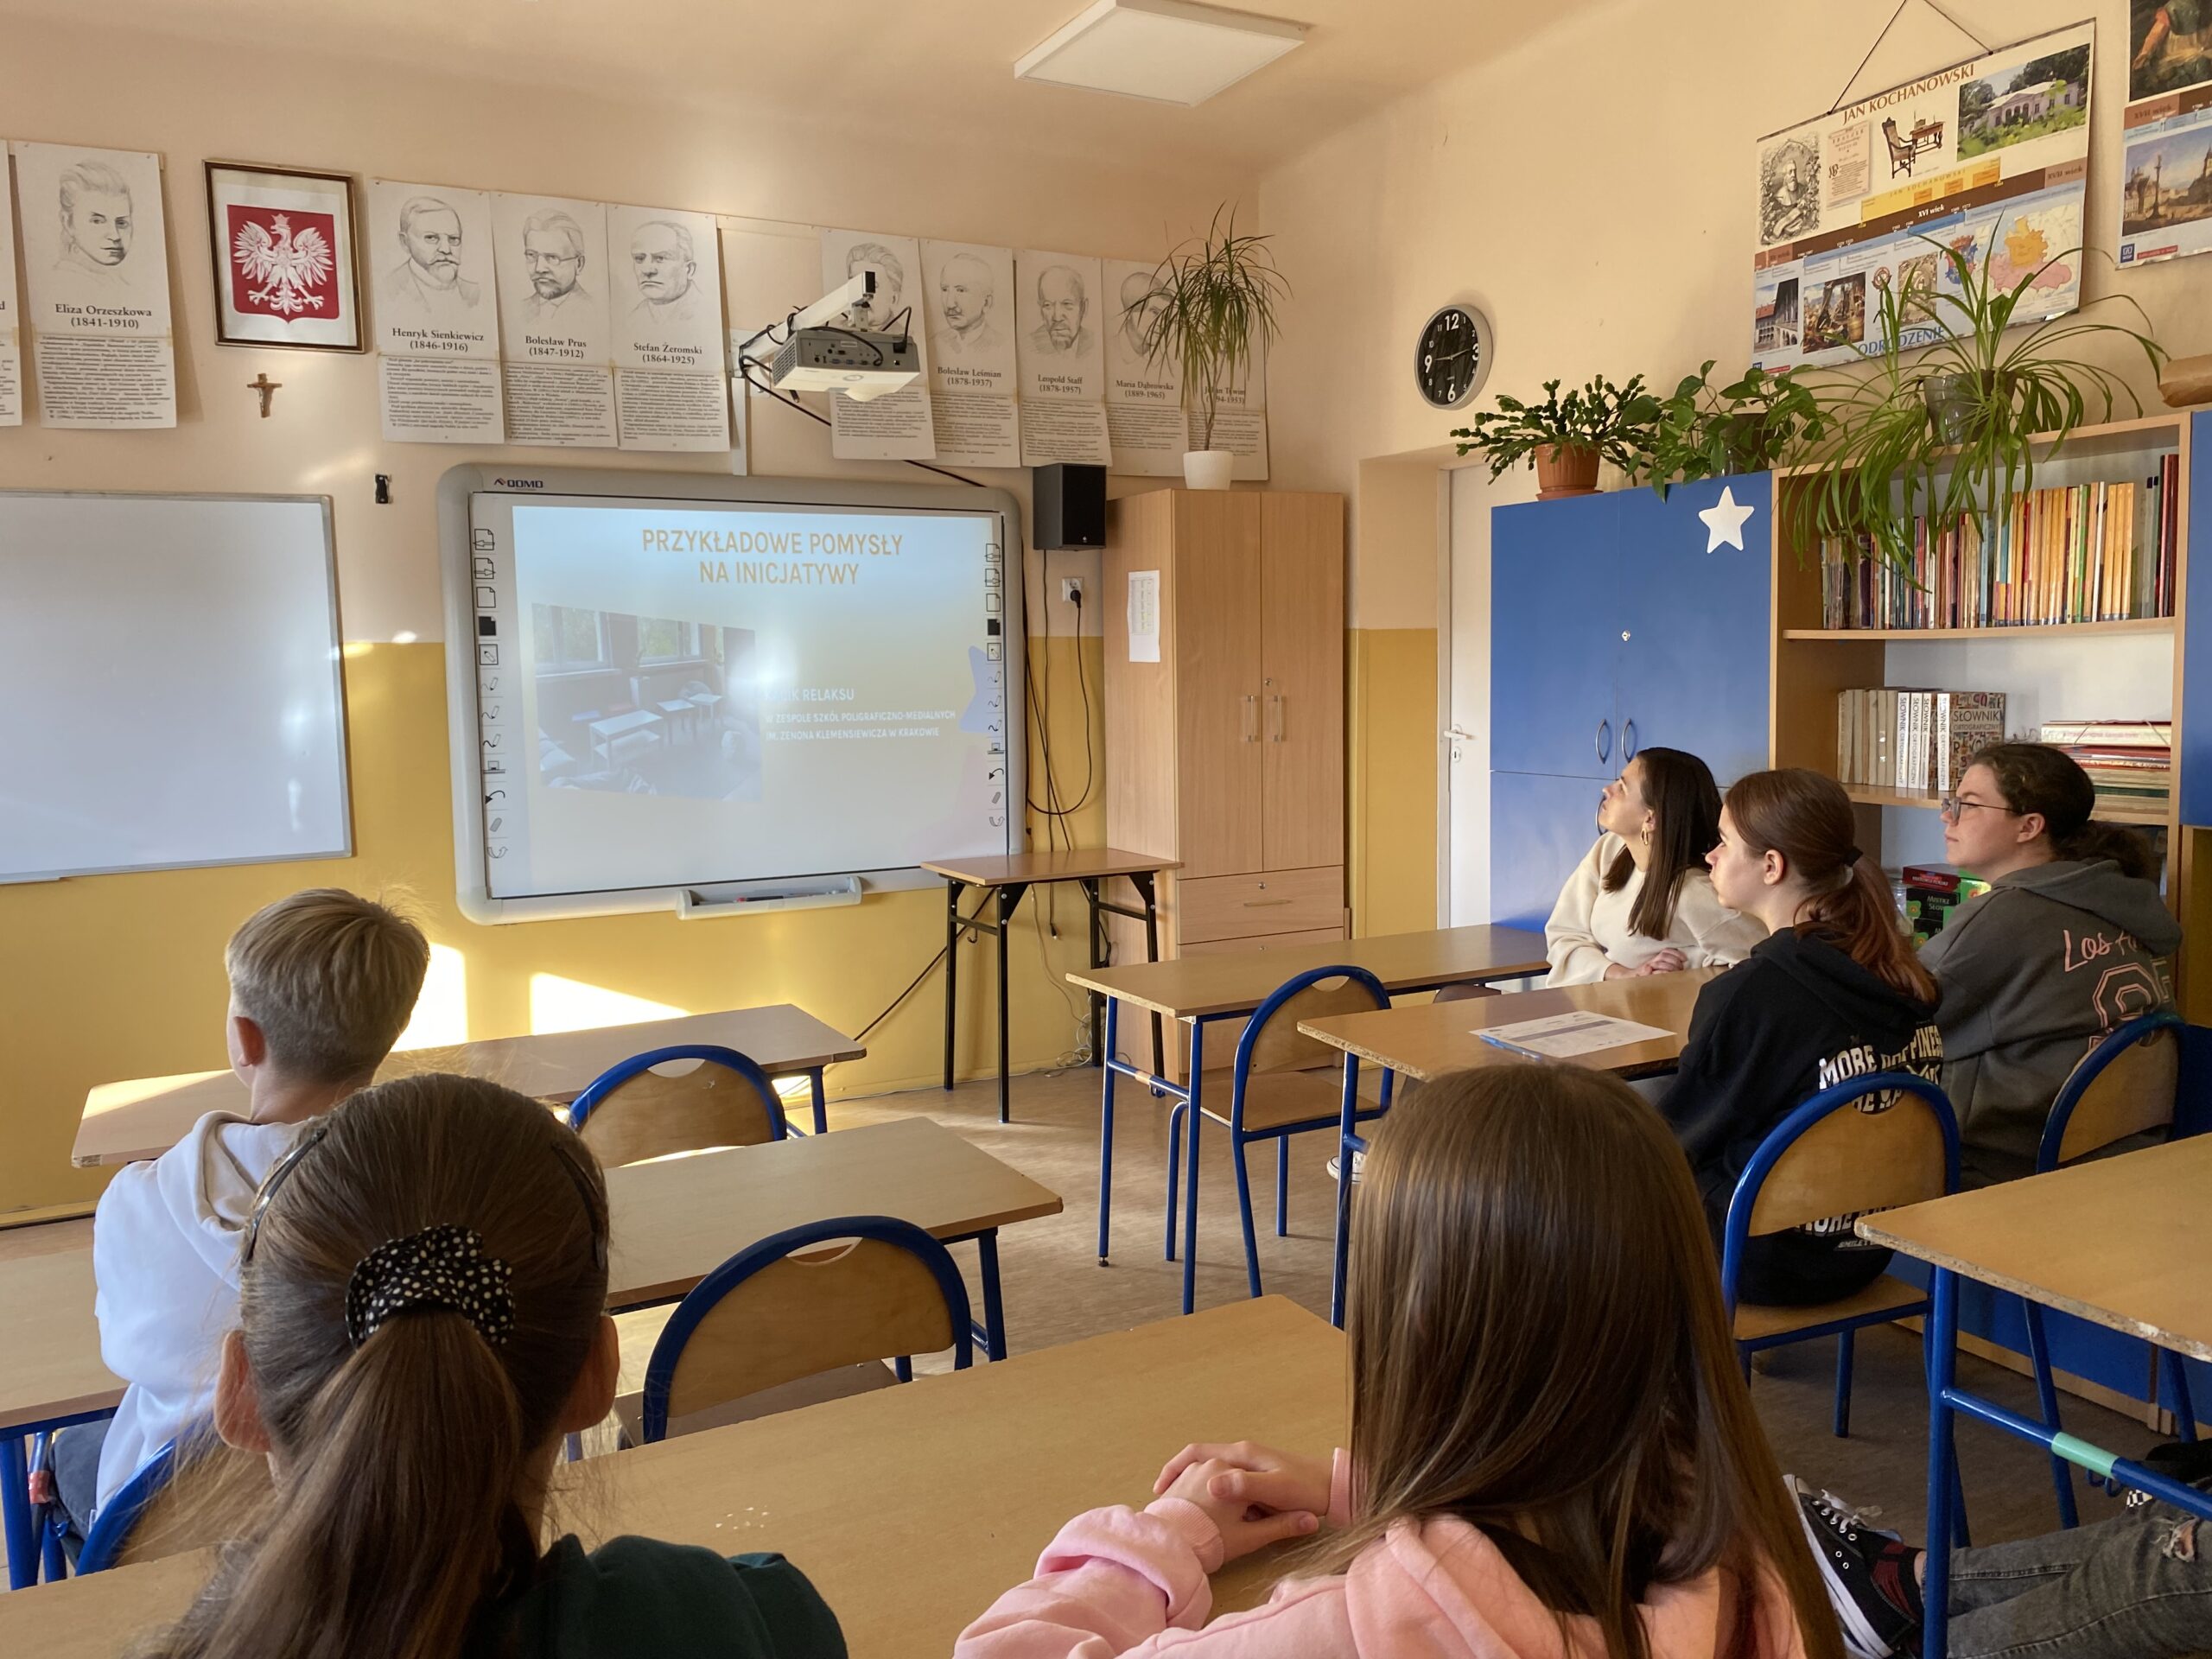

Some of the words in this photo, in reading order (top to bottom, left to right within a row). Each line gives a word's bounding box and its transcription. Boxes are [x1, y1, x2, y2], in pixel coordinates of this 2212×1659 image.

[1842, 103, 1866, 126] JAN
[1869, 63, 1975, 113] KOCHANOWSKI
[54, 303, 83, 315] Eliza
[86, 304, 152, 317] Orzeszkowa
[70, 316, 140, 329] (1841-1910)
[1437, 323, 1443, 332] 11
[1444, 313, 1459, 332] 12
[392, 327, 428, 339] Henryk
[430, 330, 485, 341] Sienkiewicz
[1471, 329, 1476, 338] 2
[410, 340, 469, 353] (1846-1916)
[524, 335, 564, 346] Bolesław
[568, 338, 588, 347] Prus
[633, 342, 660, 353] Stefan
[662, 341, 702, 354] Żeromski
[1428, 340, 1434, 349] 10
[529, 346, 584, 359] (1847-1912)
[1471, 342, 1479, 361] 3
[642, 353, 696, 365] (1864-1925)
[1424, 354, 1433, 373] 9
[947, 376, 993, 388] (1878-1937)
[1037, 374, 1065, 385] Leopold
[1066, 376, 1083, 385] Staff
[1116, 378, 1136, 389] Maria
[1137, 380, 1174, 391] Dąbrowska
[1428, 378, 1433, 386] 8
[1124, 389, 1166, 400] (1889-1965)
[1205, 395, 1245, 404] (94-1953)
[1438, 390, 1442, 398] 7
[1447, 383, 1456, 403] 6
[642, 529, 803, 555] PRZYKŁADOWE
[810, 532, 903, 556] POMYSŁY
[699, 561, 729, 583] NA
[735, 562, 859, 585] INICJATYWY
[802, 687, 855, 702] RELAKSU
[776, 712, 811, 723] ZESPOLE
[813, 709, 840, 722] SZKÓŁ
[842, 709, 957, 722] POLIGRAFICZNO-MEDIALNYCH
[1953, 709, 1999, 722] SŁOWNIK
[779, 729, 814, 741] ZENONA
[899, 727, 940, 738] KRAKOWIE
[2063, 929, 2113, 972] Los
[1819, 1044, 1878, 1091] MORE
